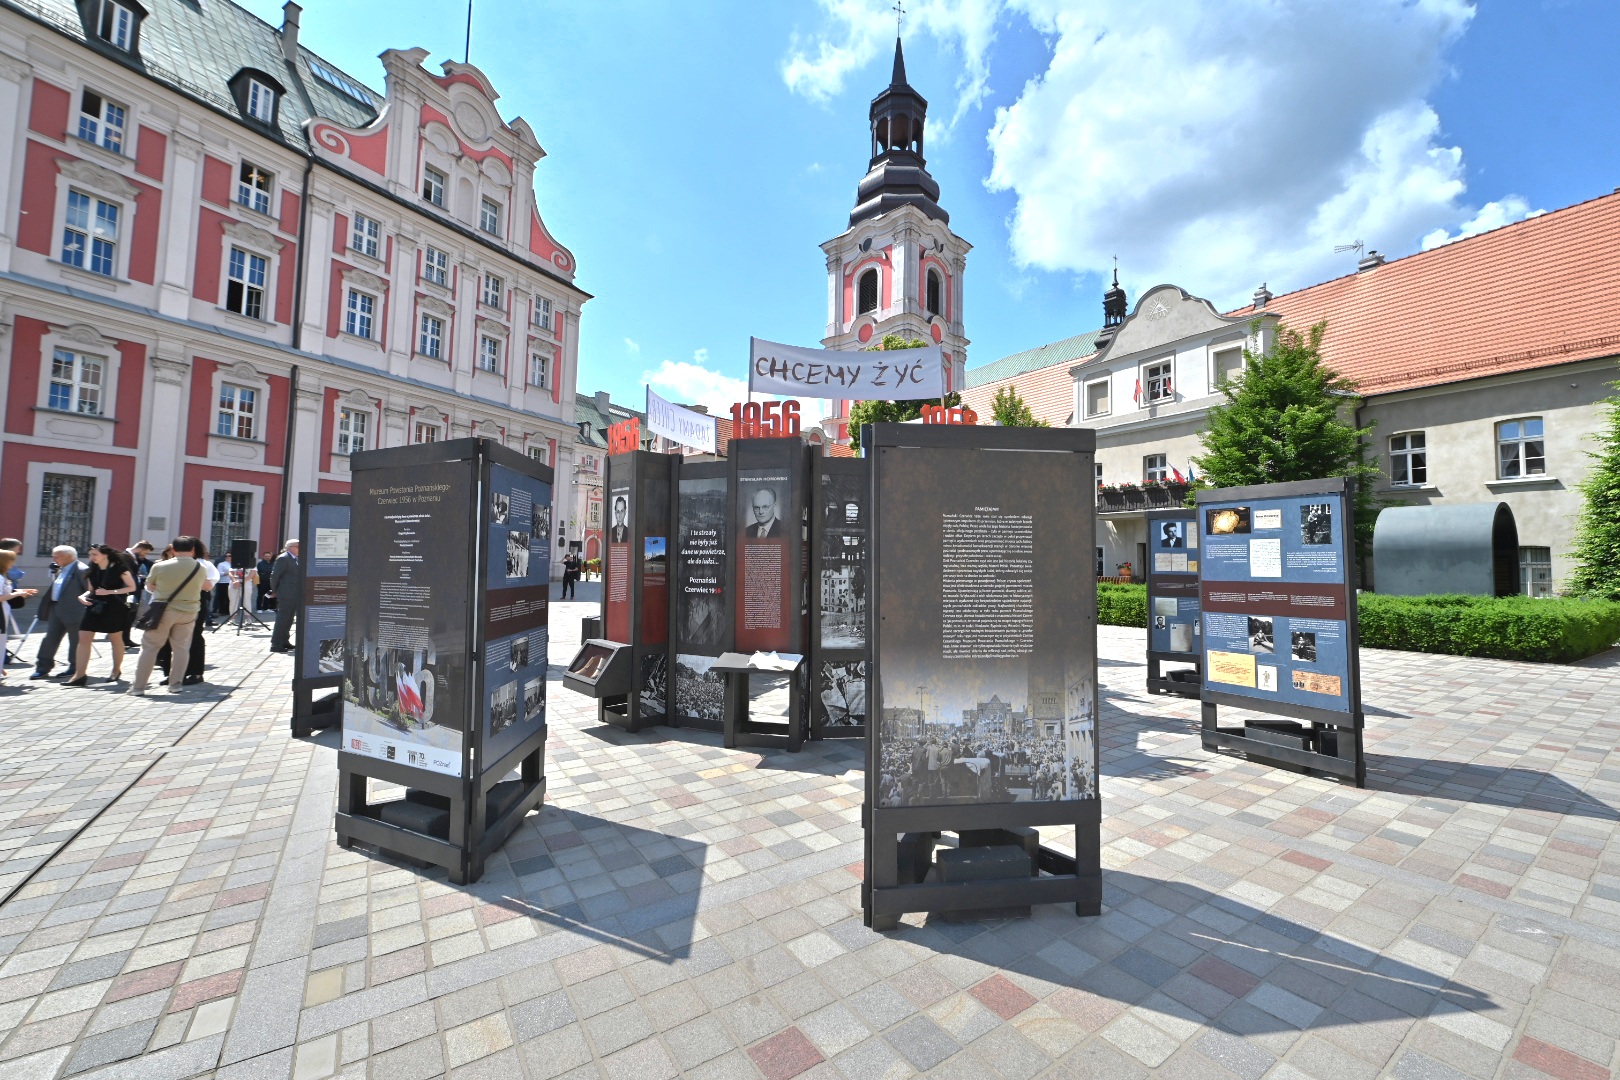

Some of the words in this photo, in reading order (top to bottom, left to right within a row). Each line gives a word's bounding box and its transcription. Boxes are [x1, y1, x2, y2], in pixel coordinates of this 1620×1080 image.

[756, 356, 860, 388] CHCEMY
[870, 358, 924, 388] ŻYĆ
[607, 416, 640, 456] 1956
[730, 400, 800, 440] 1956
[378, 497, 398, 505] Czerwiec
[699, 529, 716, 537] strzały
